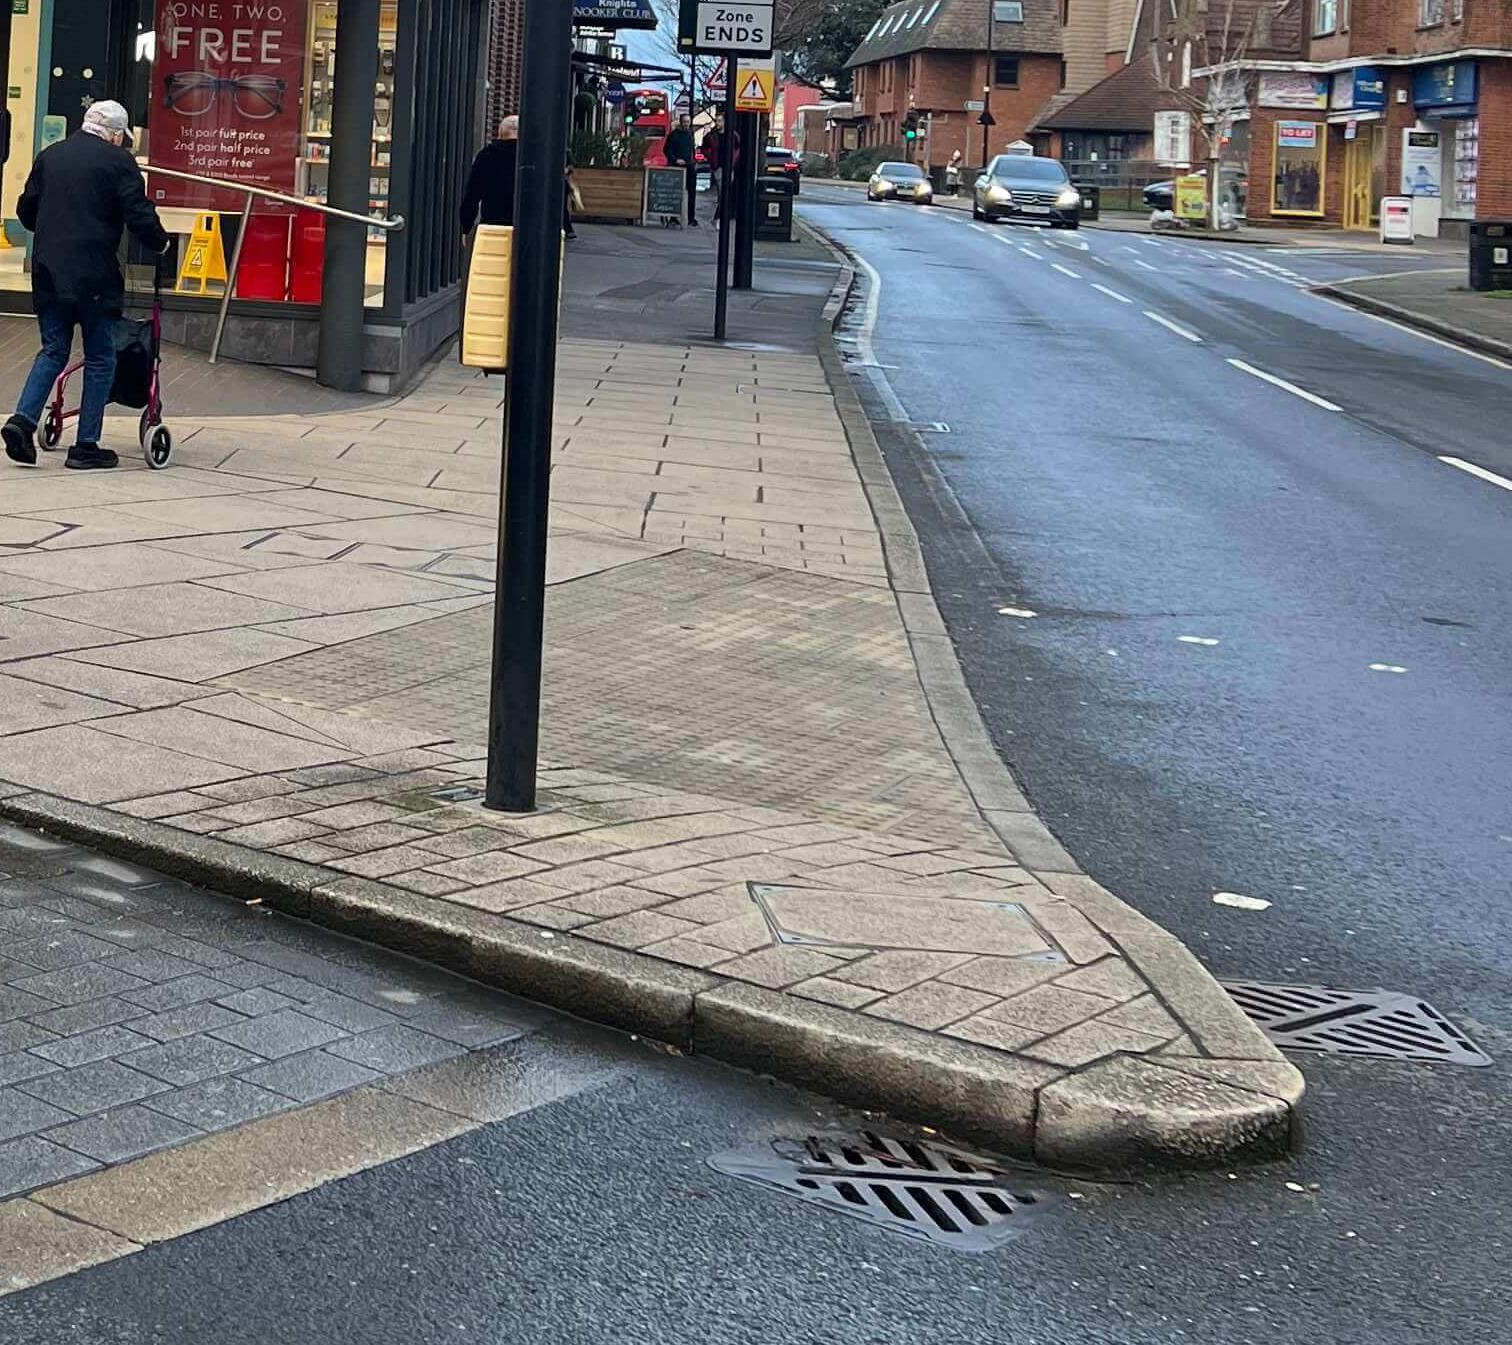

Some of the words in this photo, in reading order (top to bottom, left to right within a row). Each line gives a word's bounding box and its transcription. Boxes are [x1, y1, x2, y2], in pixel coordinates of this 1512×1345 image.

[173, 3, 223, 20] ONE,
[232, 5, 287, 23] TWO,
[573, 6, 618, 17] NOOKER
[623, 8, 650, 19] CLUB
[716, 9, 754, 22] Zone
[704, 26, 764, 43] ENDS
[172, 26, 283, 64] FREE
[180, 126, 193, 137] 1st
[196, 127, 217, 138] pair
[219, 128, 236, 138] full
[238, 130, 266, 141] price
[174, 140, 195, 151] 2nd
[197, 142, 218, 154] pair
[220, 143, 242, 154] half
[243, 146, 271, 157] price
[188, 154, 206, 166] 3rd
[208, 157, 229, 168] pair
